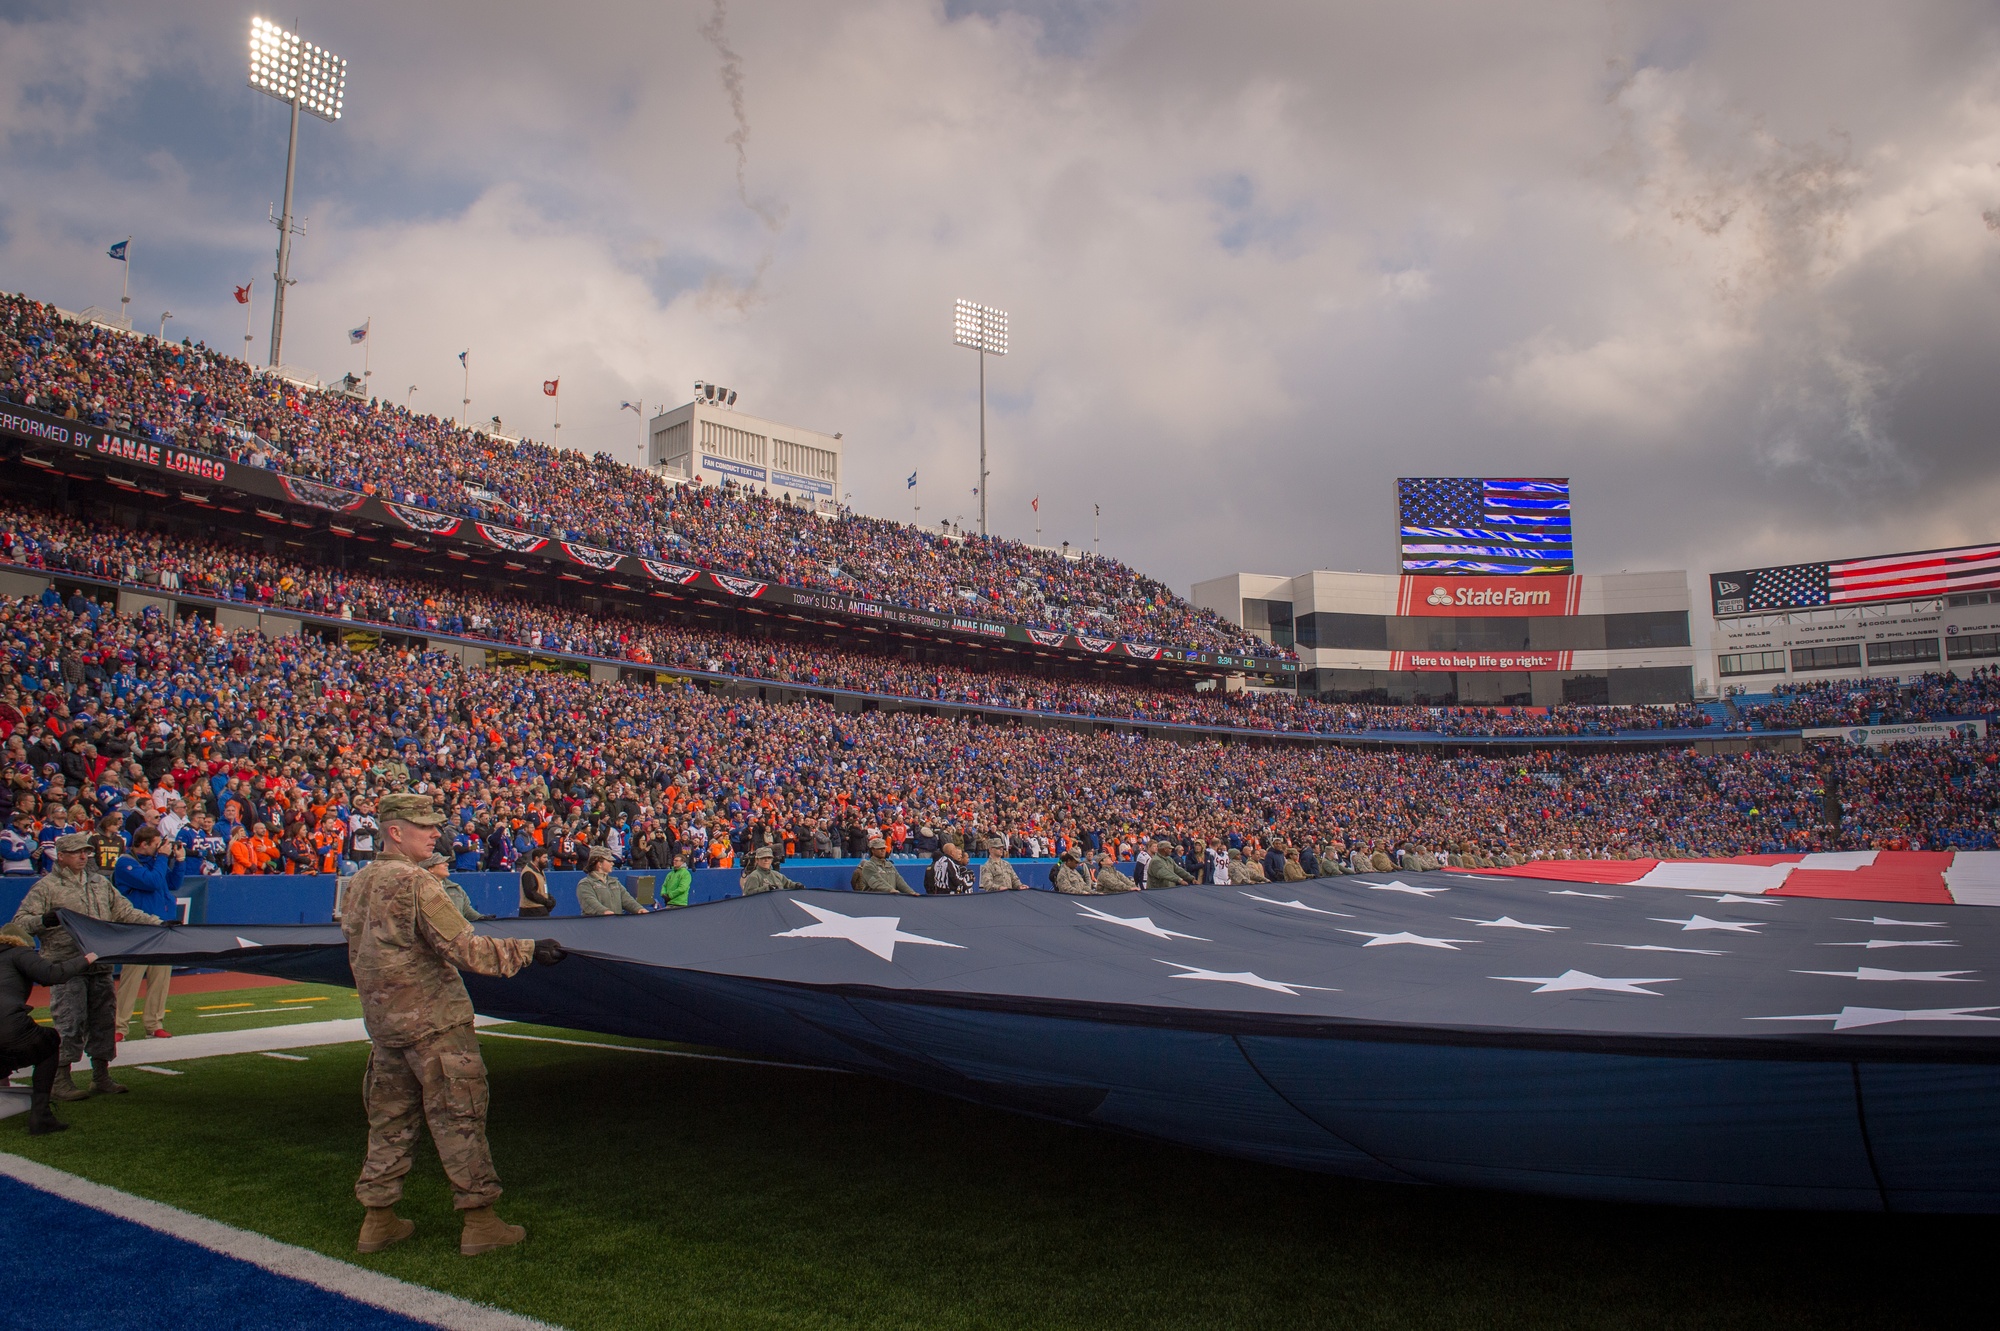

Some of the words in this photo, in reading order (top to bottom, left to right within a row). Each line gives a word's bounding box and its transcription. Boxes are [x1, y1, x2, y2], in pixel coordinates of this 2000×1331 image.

[74, 431, 93, 449] BY
[96, 433, 161, 466] JANAE
[166, 450, 226, 481] LONGO
[704, 459, 715, 467] FAN
[715, 462, 740, 473] CONDUCT
[741, 467, 752, 476] TEXT
[753, 470, 765, 479] LINE
[1719, 604, 1743, 612] FIELD
[793, 593, 820, 607] TODAY's
[822, 595, 846, 612] U.S.A.
[847, 600, 883, 618] ANTHEM
[884, 609, 898, 621] WILL
[898, 612, 907, 622] BE
[908, 613, 940, 628] PERFORMED
[942, 619, 950, 629] BY
[951, 618, 978, 633] JANAE
[979, 622, 1006, 638] LONGO
[1948, 626, 1957, 634] 78
[49, 661, 59, 672] 15
[1217, 656, 1232, 665] 3:34
[1411, 655, 1437, 666] Here
[1439, 656, 1451, 666] to
[1453, 655, 1477, 668] help
[1479, 655, 1497, 666] life
[1500, 657, 1513, 668] go
[1871, 727, 1906, 735] connors
[1918, 724, 1944, 732] ferris,
[100, 852, 118, 867] 17
